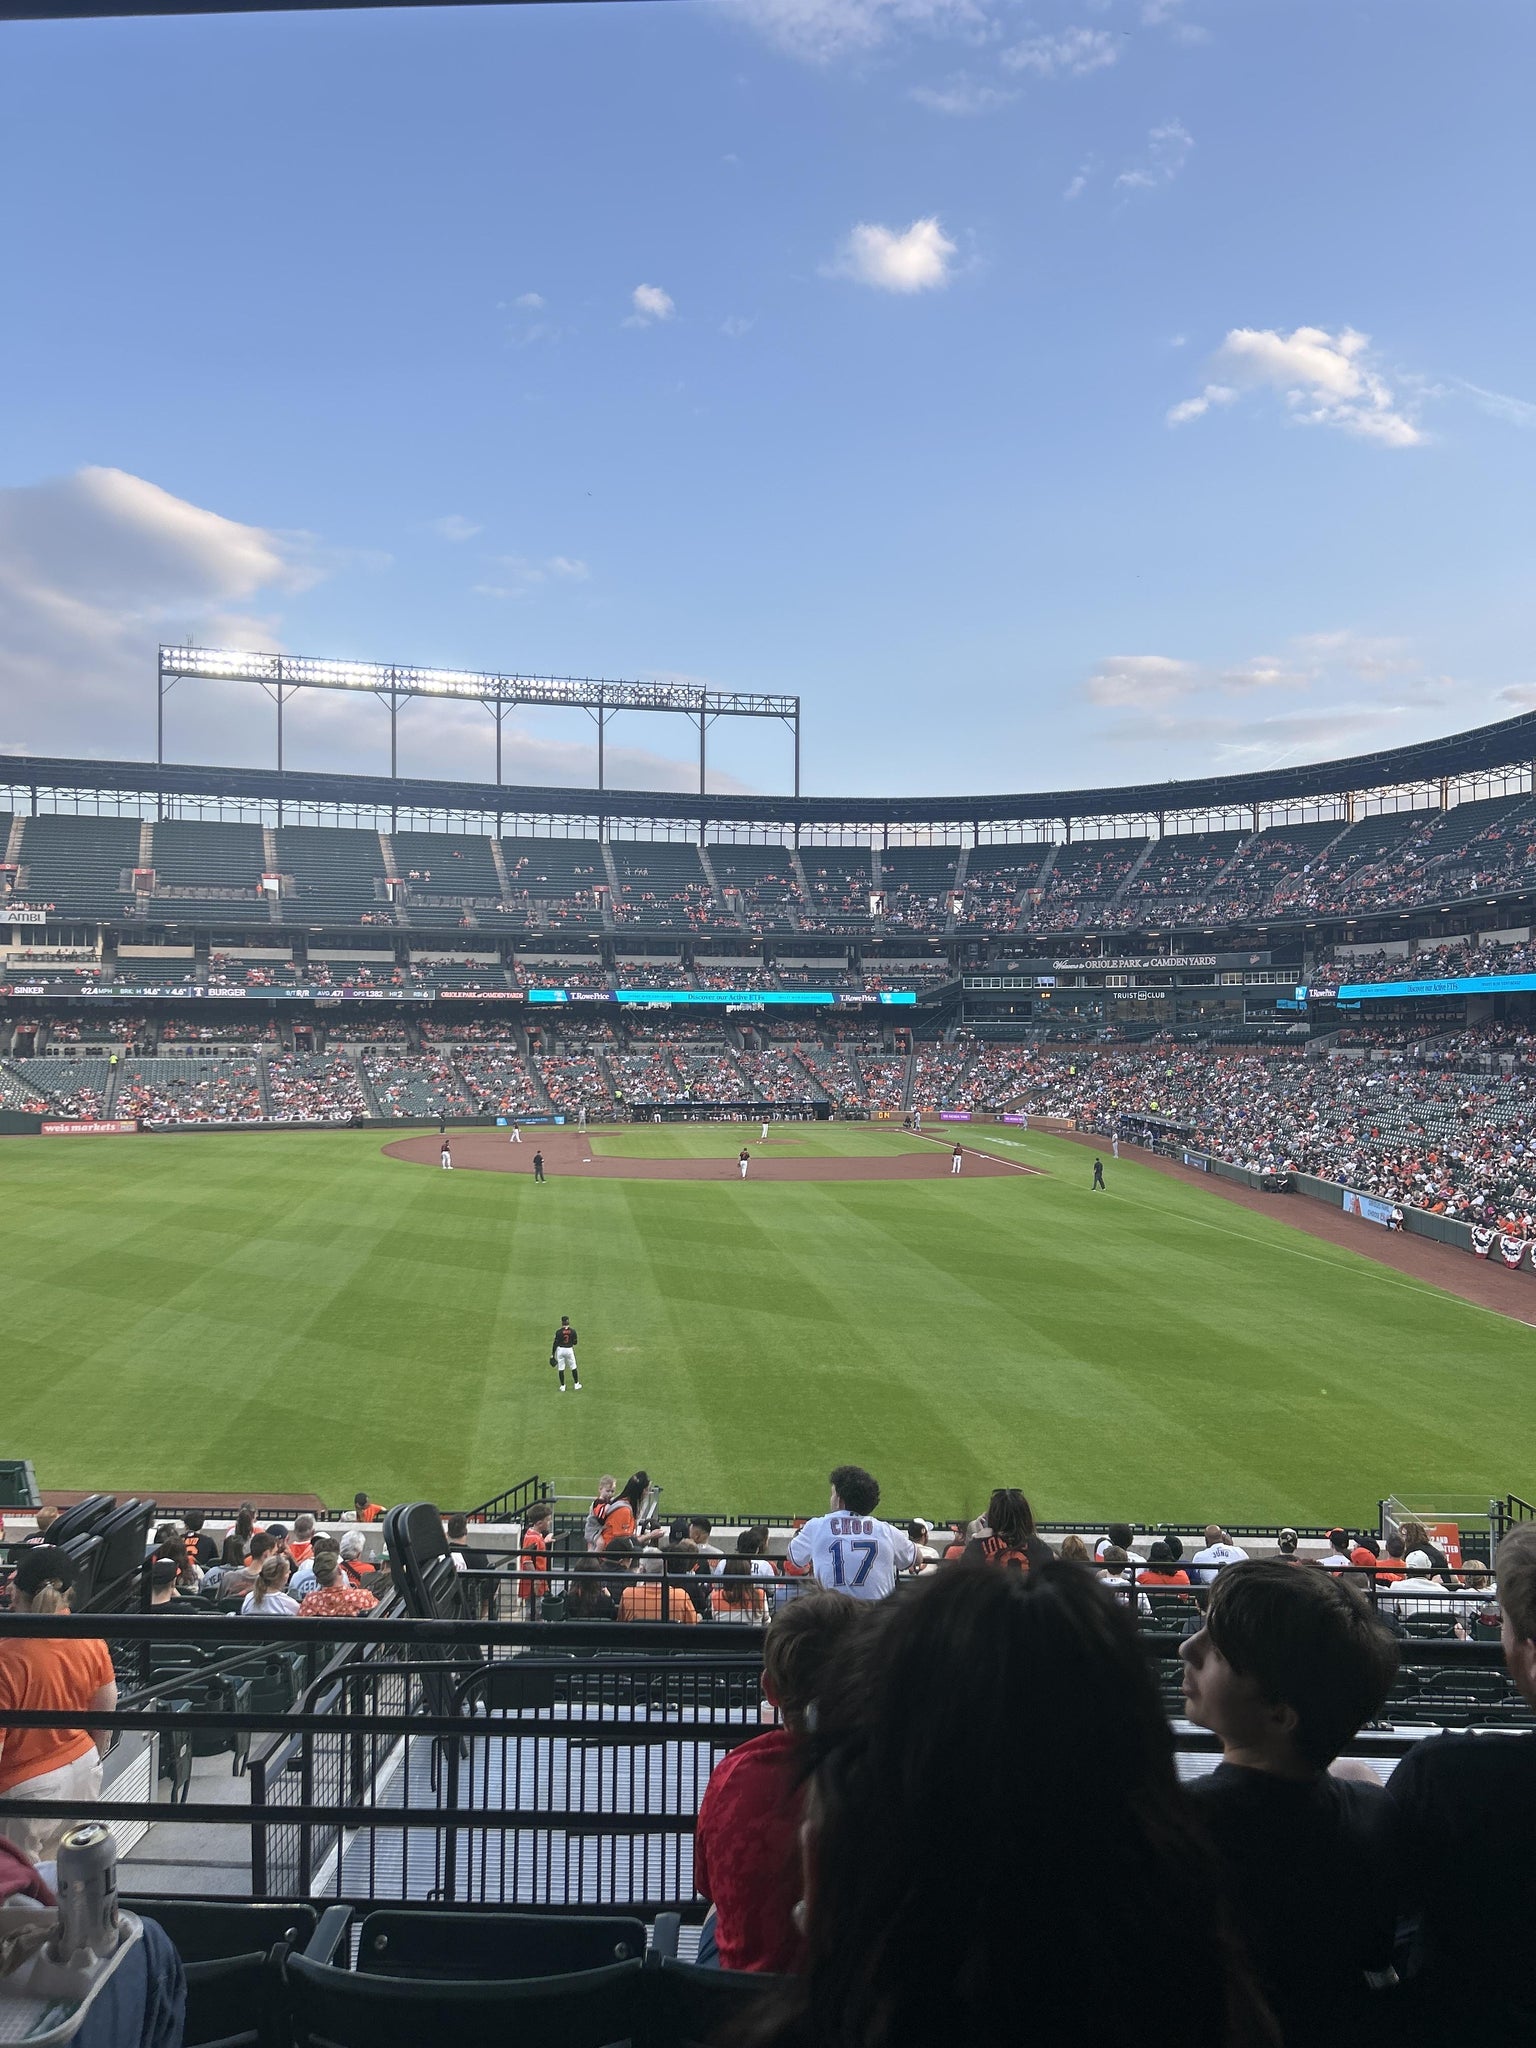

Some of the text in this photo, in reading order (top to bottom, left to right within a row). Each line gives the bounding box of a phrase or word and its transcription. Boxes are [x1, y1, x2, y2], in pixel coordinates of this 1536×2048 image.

[1085, 960, 1118, 969] ORIOLE
[1119, 959, 1141, 968] PARK
[1150, 958, 1188, 967] CAMDEN
[1189, 956, 1217, 965] YARDS
[14, 986, 45, 994] SINKER
[208, 987, 246, 997] BURGER
[1147, 991, 1165, 999] CLUB
[44, 1122, 116, 1133] weis markets
[830, 1517, 873, 1536] CHOO
[1212, 1549, 1229, 1559] JUNG
[828, 1538, 879, 1587] 17
